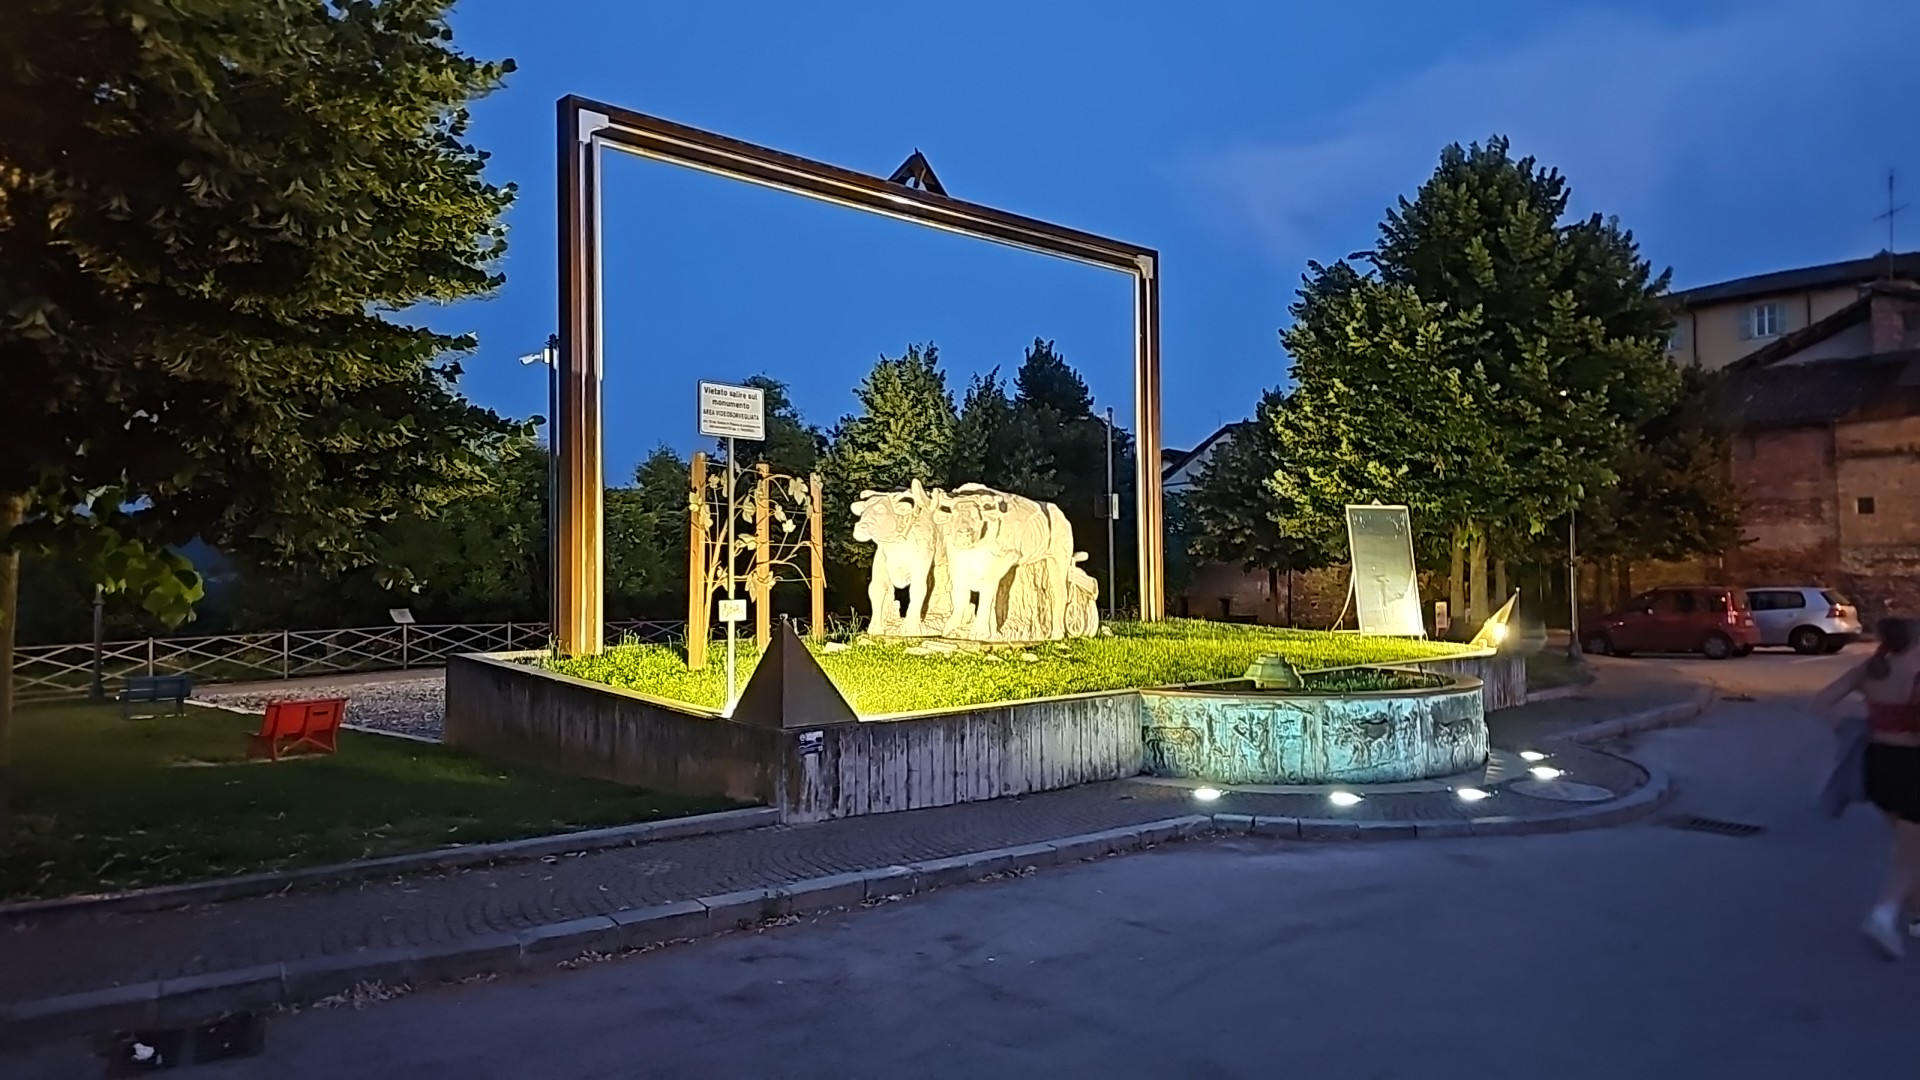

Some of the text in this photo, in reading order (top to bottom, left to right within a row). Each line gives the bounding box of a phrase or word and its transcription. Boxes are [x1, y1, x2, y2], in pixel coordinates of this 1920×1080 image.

[704, 386, 727, 396] Vietato
[729, 391, 747, 399] salire
[712, 399, 750, 409] monumento
[703, 408, 715, 416] AREA
